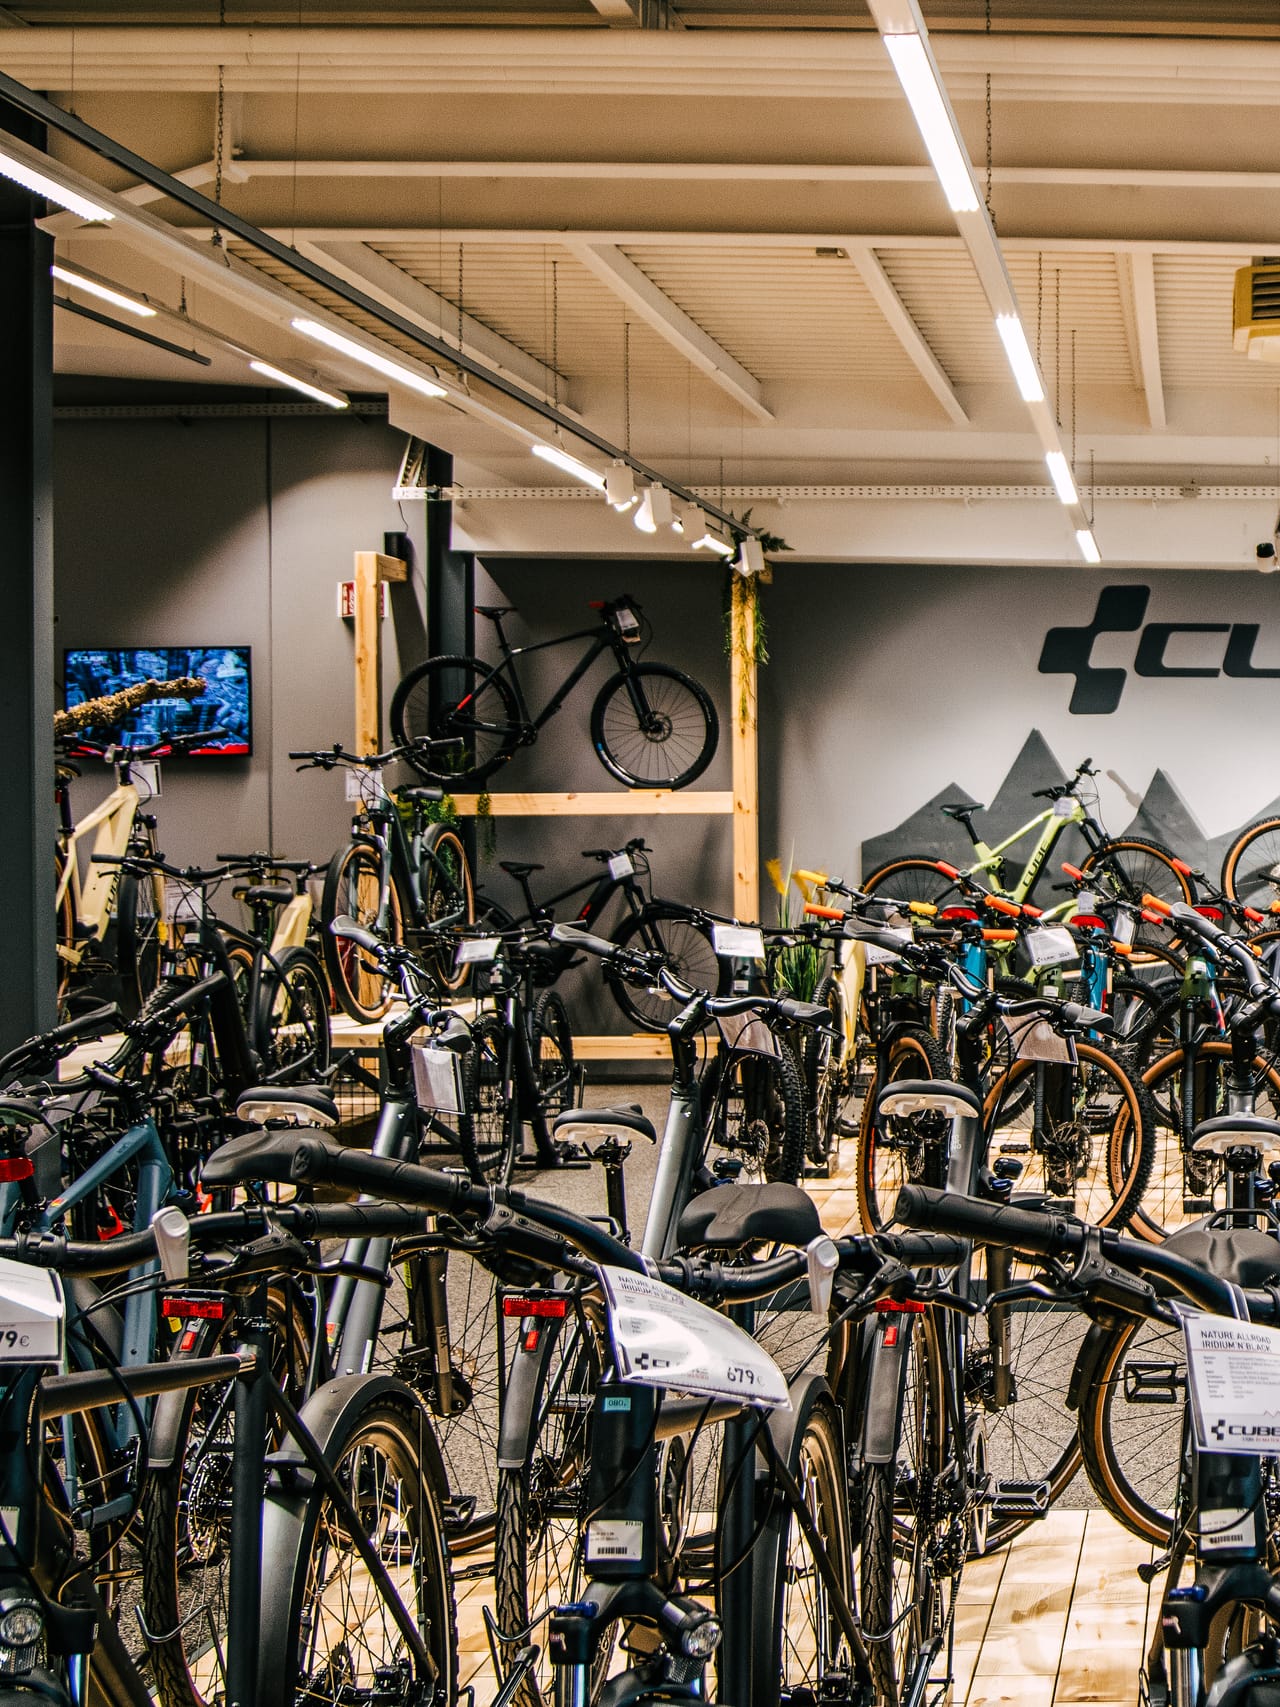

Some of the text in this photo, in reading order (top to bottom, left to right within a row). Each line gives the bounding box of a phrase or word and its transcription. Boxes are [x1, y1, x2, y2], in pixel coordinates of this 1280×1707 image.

[1022, 840, 1050, 887] CUBE
[1200, 1330, 1272, 1344] NATURE ALLROAD
